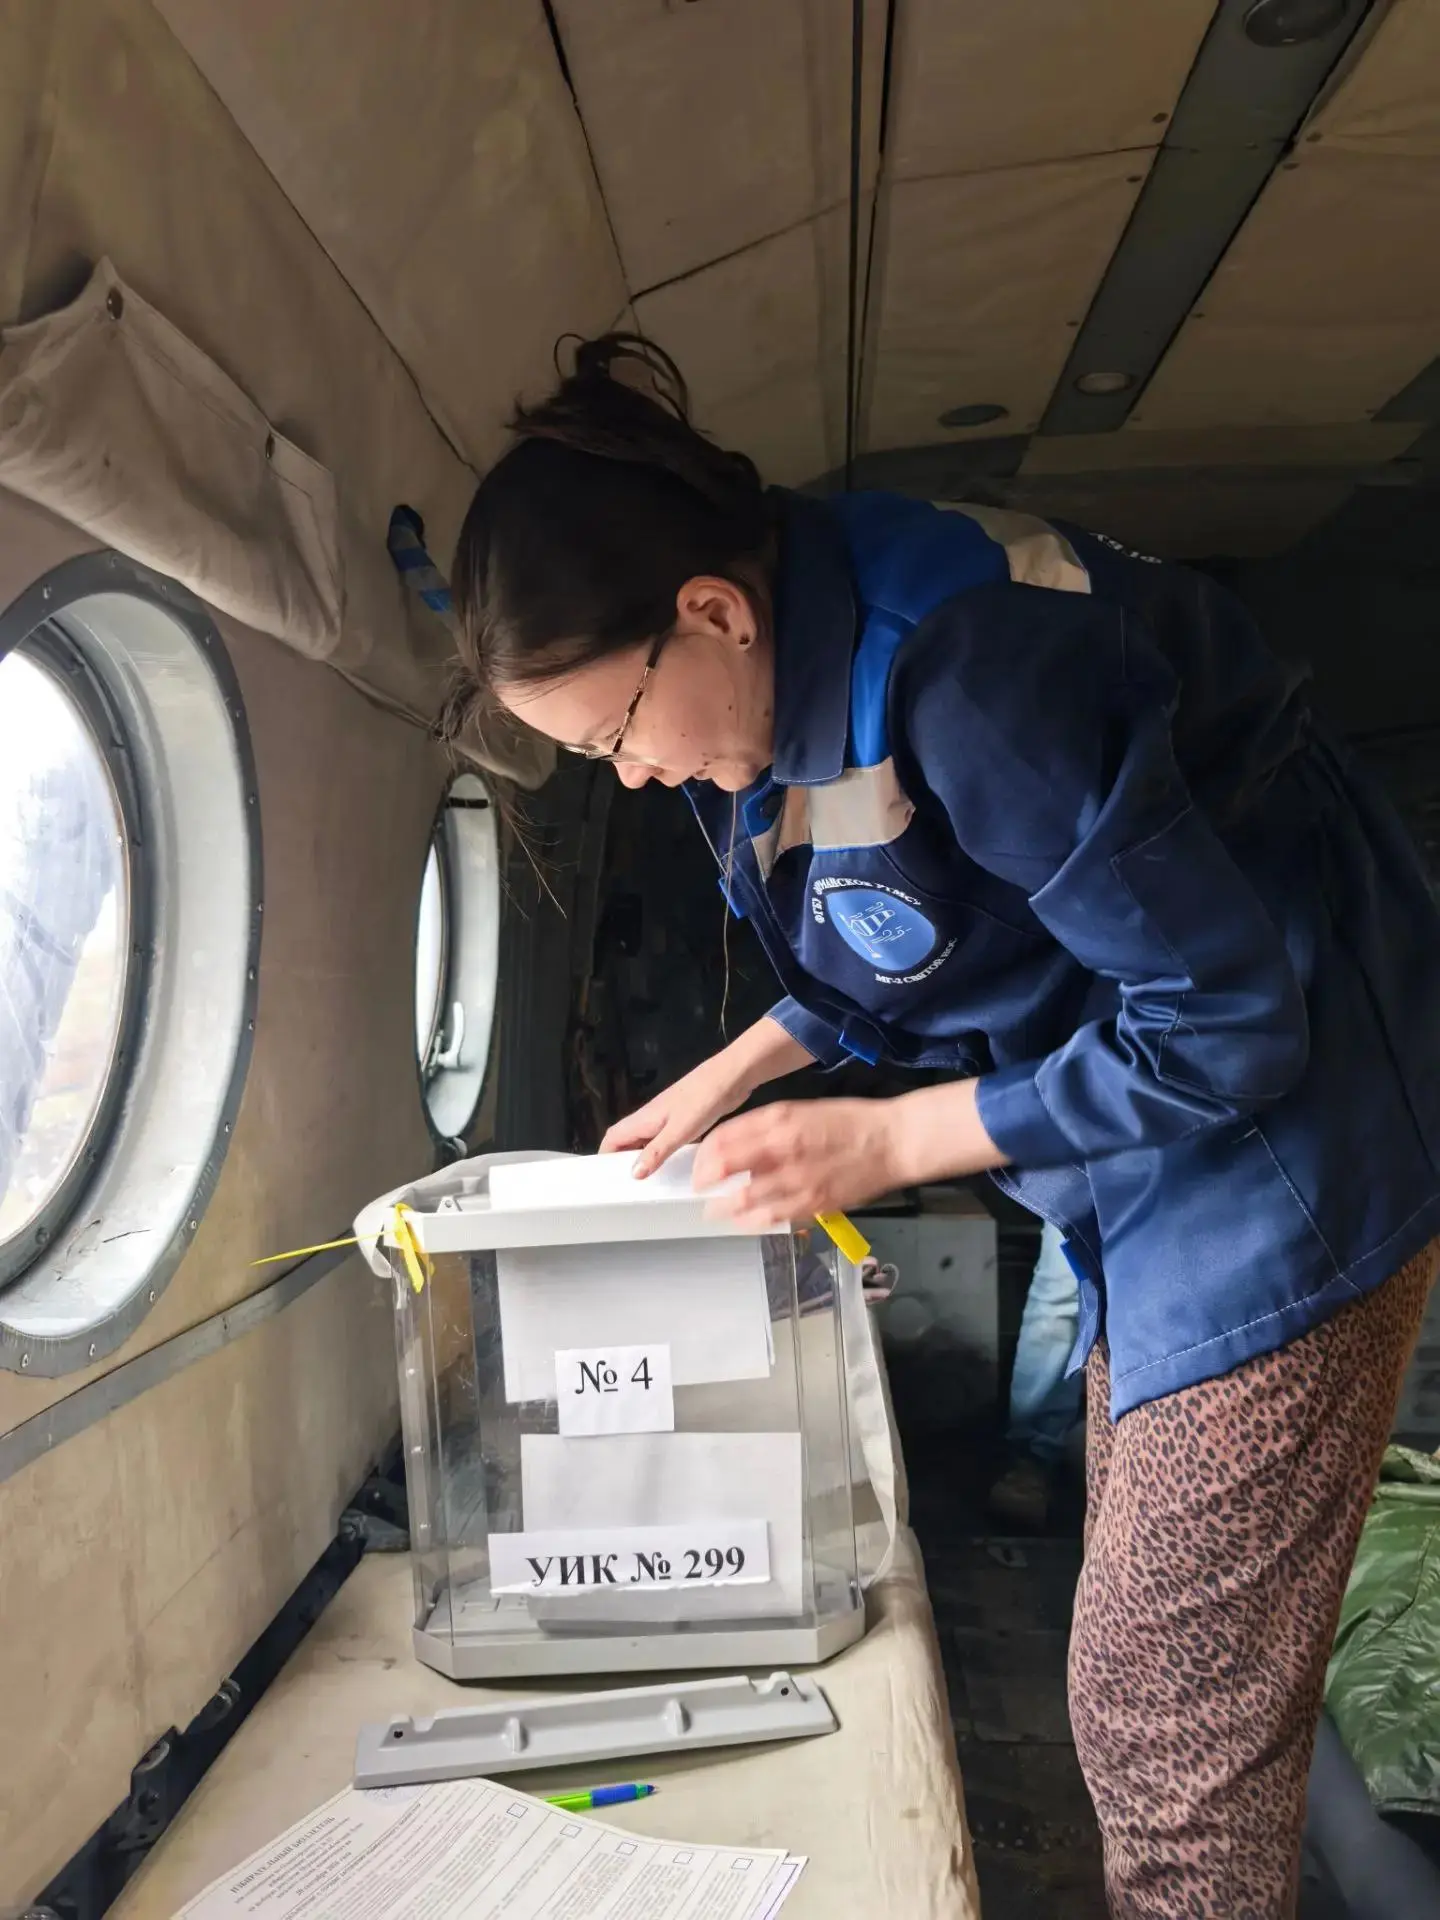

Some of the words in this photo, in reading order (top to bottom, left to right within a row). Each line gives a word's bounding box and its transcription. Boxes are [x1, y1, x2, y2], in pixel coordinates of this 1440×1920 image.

[575, 1360, 619, 1395] №
[631, 1357, 653, 1391] 4
[526, 1553, 618, 1588] УИК
[631, 1550, 672, 1583] №
[683, 1546, 746, 1580] 299
